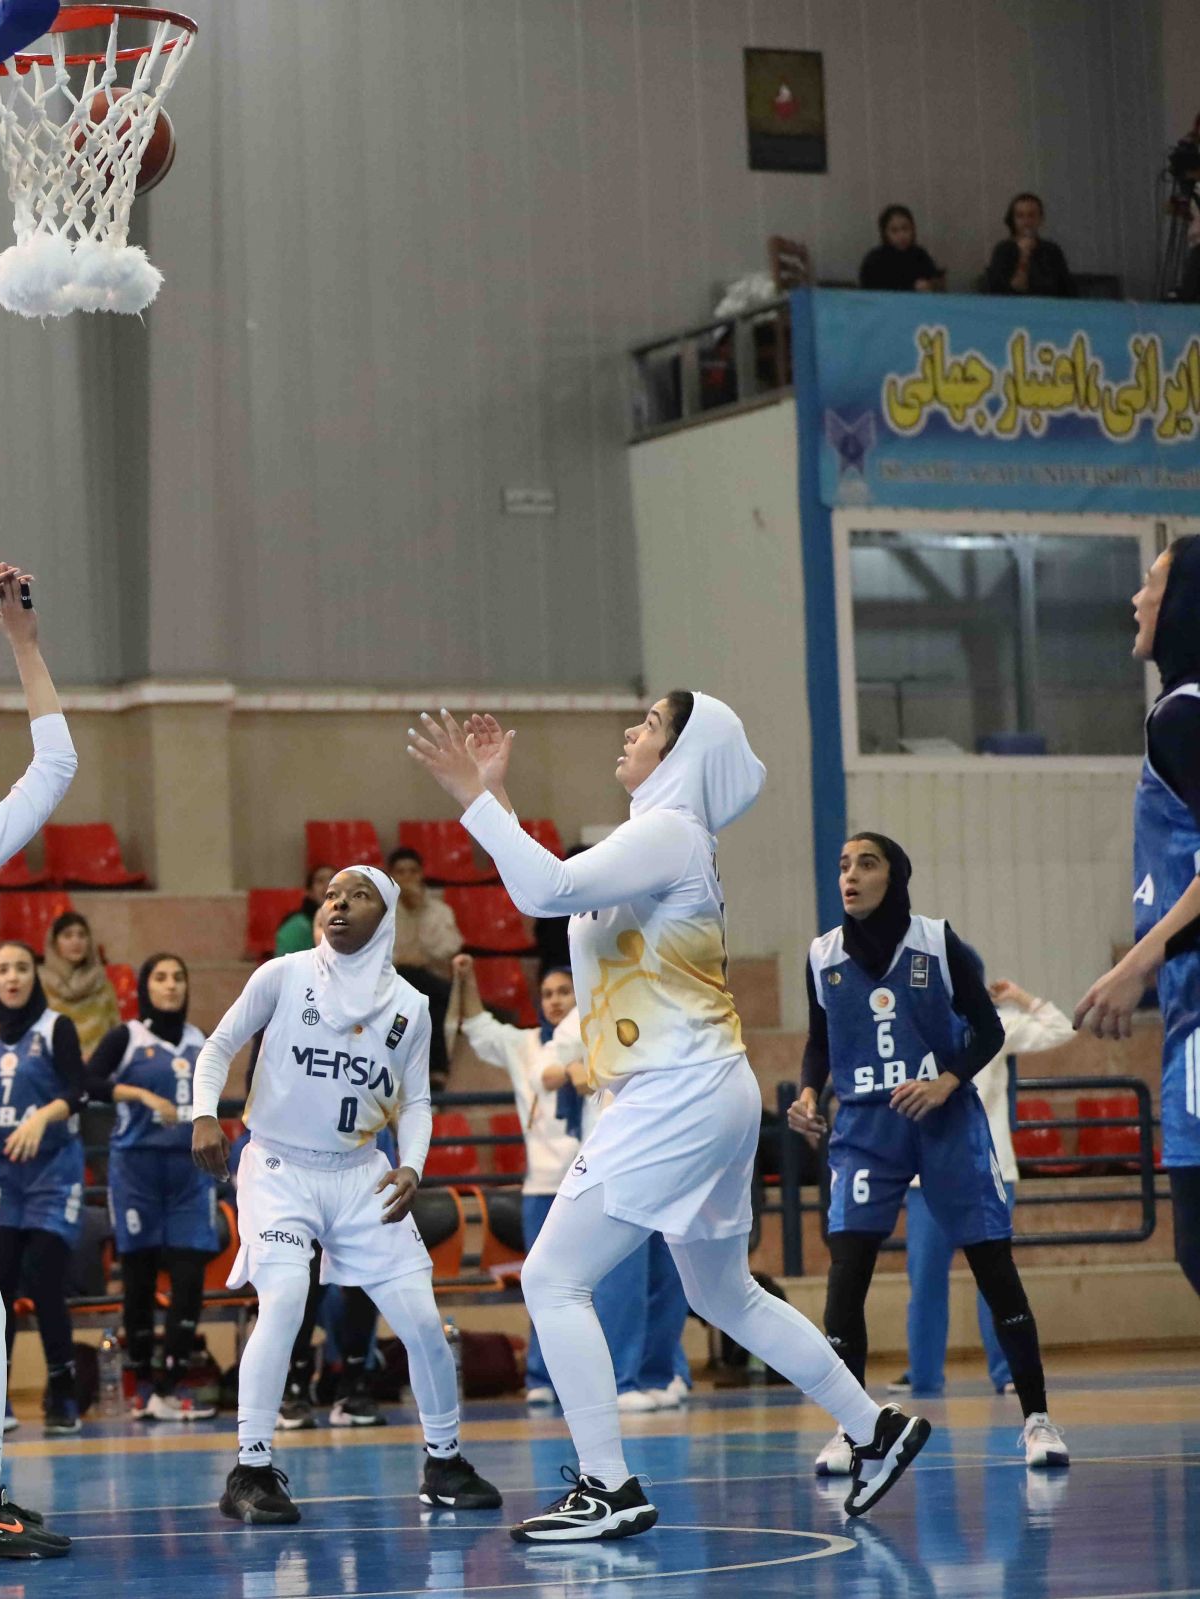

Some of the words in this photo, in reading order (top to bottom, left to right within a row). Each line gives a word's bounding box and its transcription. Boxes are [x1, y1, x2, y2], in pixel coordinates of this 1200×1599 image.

[886, 328, 994, 429] جهانی
[995, 331, 1088, 435] اعتبار
[876, 1021, 895, 1058] 6
[854, 1051, 939, 1094] S.BA
[337, 1096, 359, 1134] 0
[852, 1168, 871, 1205] 6
